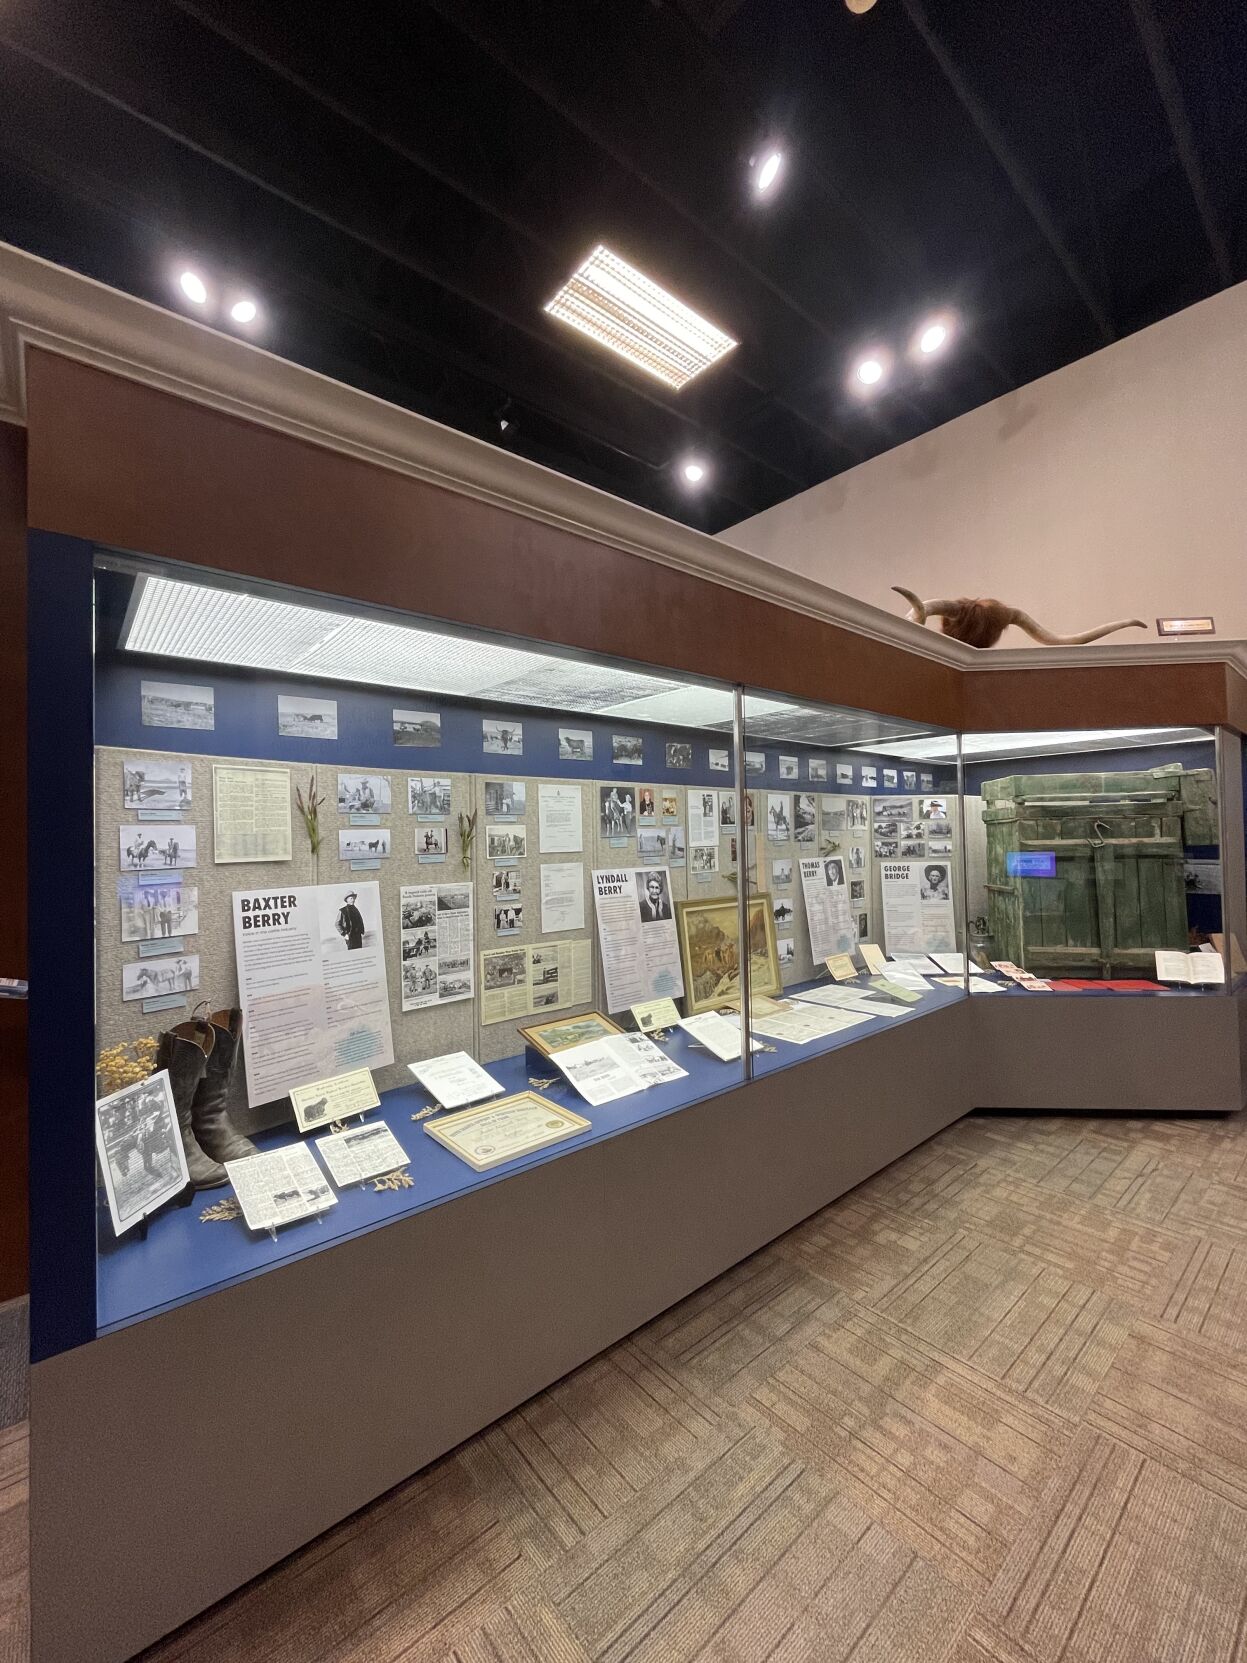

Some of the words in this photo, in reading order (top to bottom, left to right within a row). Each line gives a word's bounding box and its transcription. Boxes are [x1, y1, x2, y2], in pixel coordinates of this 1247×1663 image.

[597, 874, 628, 884] LYNDALL
[598, 885, 622, 895] BERRY
[241, 895, 297, 912] BAXTER
[242, 912, 291, 929] BERRY
